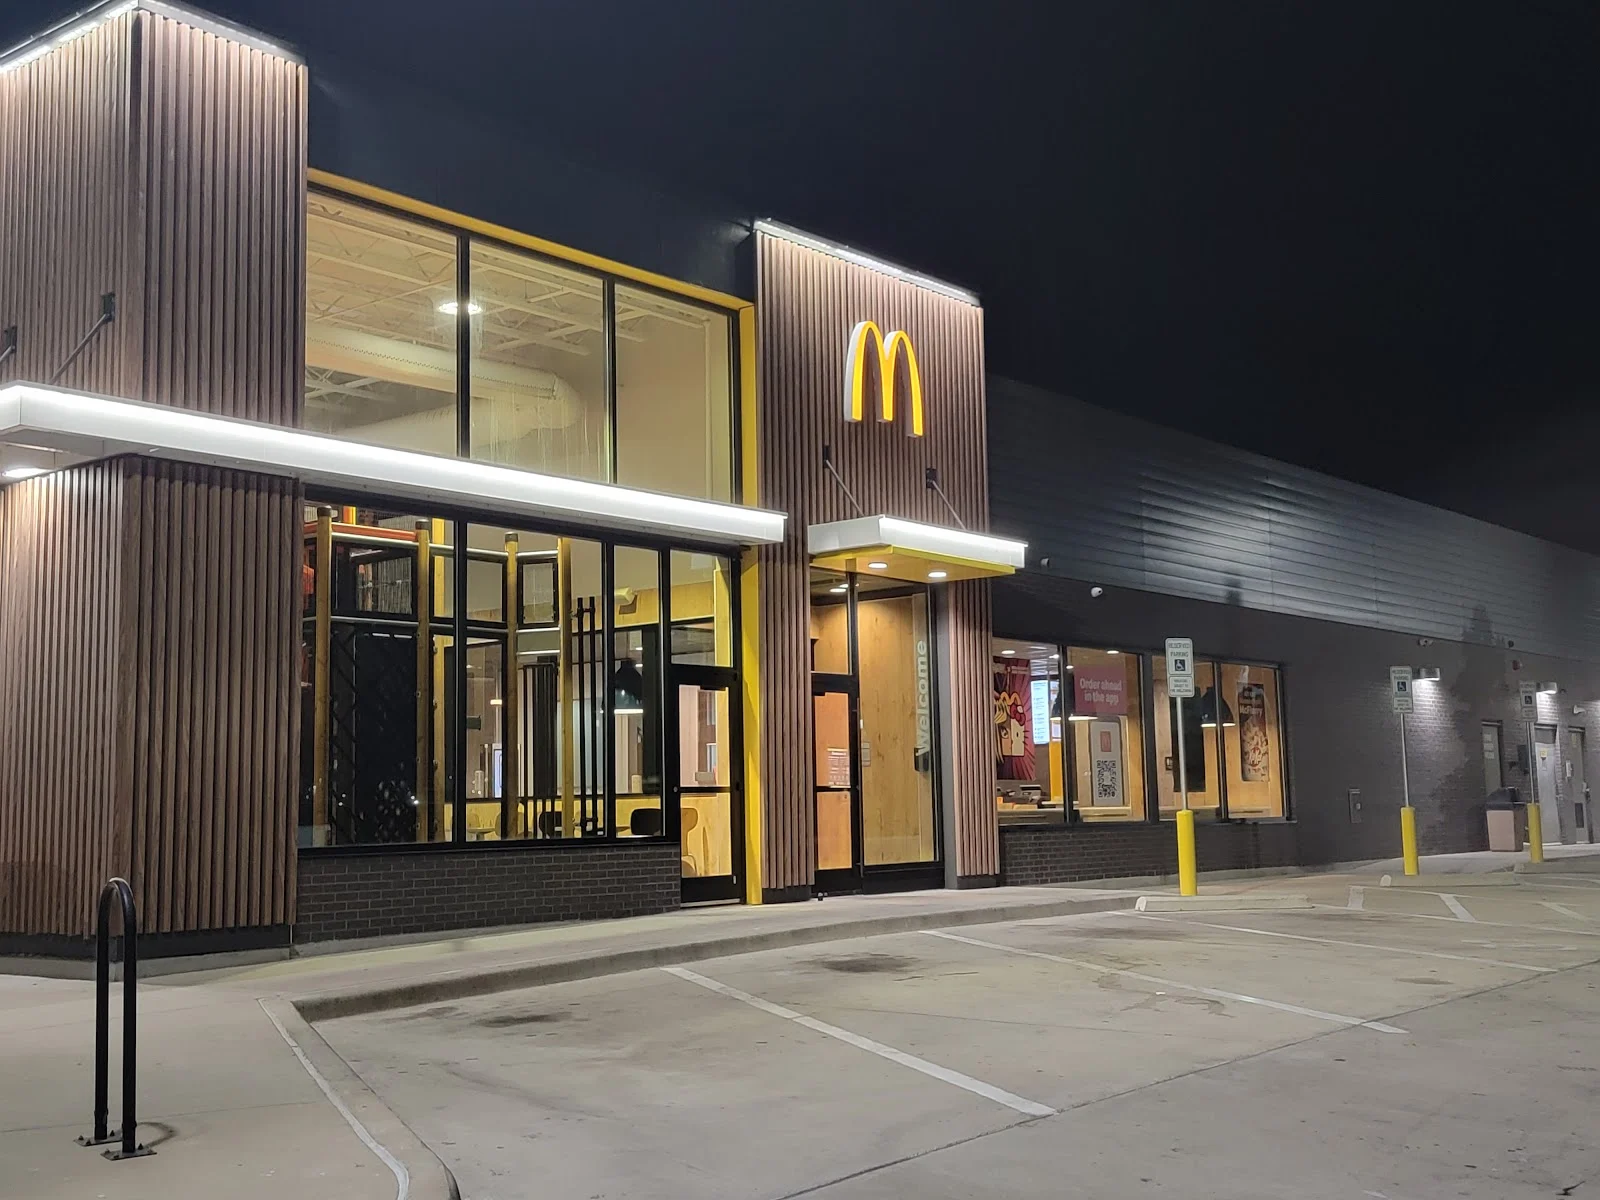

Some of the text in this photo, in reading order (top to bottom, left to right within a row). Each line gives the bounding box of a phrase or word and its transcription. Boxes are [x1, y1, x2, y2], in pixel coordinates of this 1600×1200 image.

[1079, 677, 1122, 691] Order ahead
[1084, 690, 1119, 706] in the app
